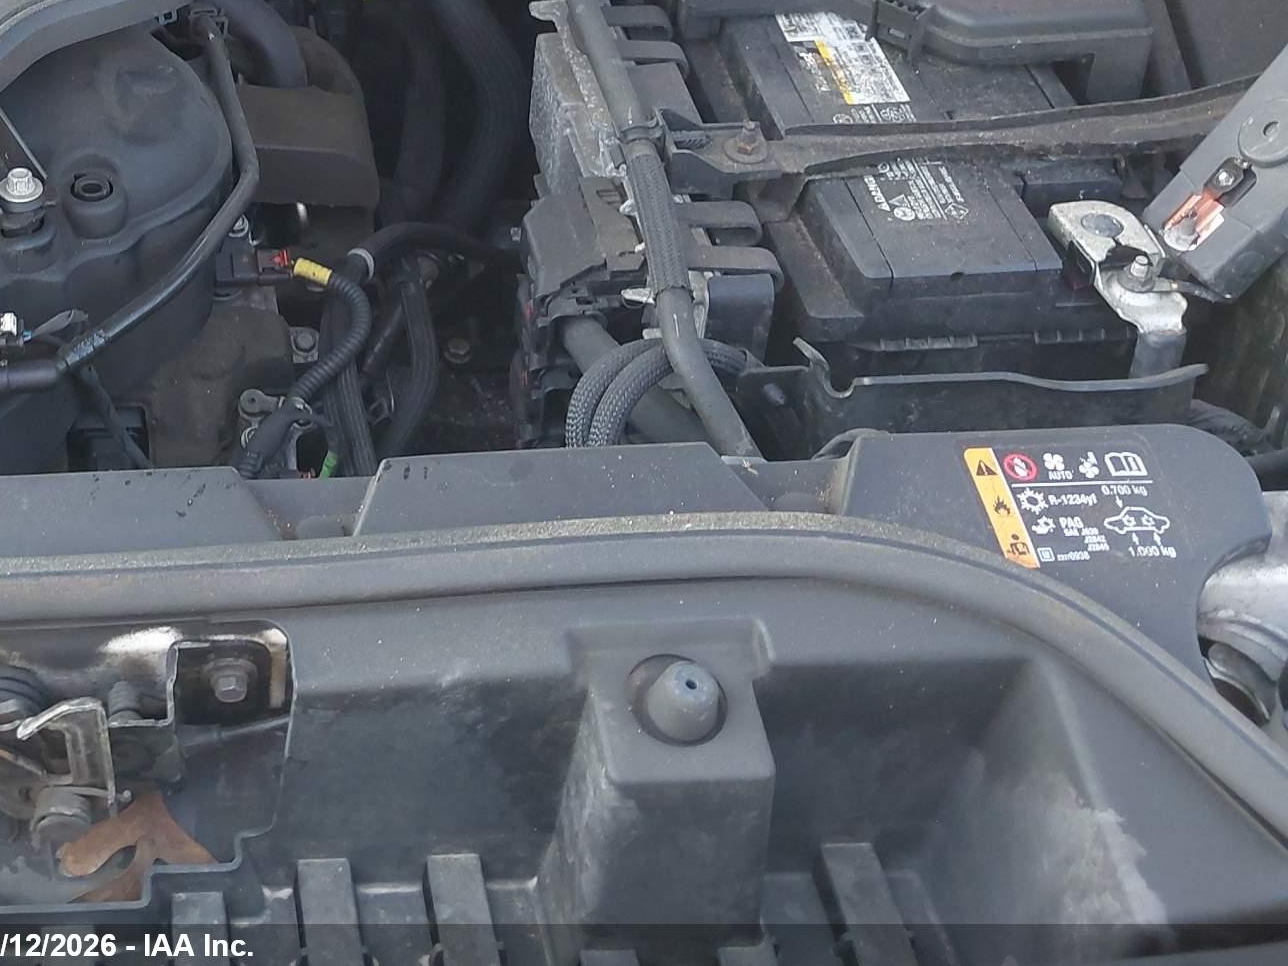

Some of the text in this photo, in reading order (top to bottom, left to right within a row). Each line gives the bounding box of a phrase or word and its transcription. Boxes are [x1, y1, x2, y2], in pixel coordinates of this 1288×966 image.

[1048, 471, 1072, 480] AUTO
[1101, 485, 1148, 497] 0.700 kg
[1048, 493, 1098, 507] R-1234yf
[1059, 517, 1084, 528] PAG
[1128, 544, 1177, 558] 1.000 kg
